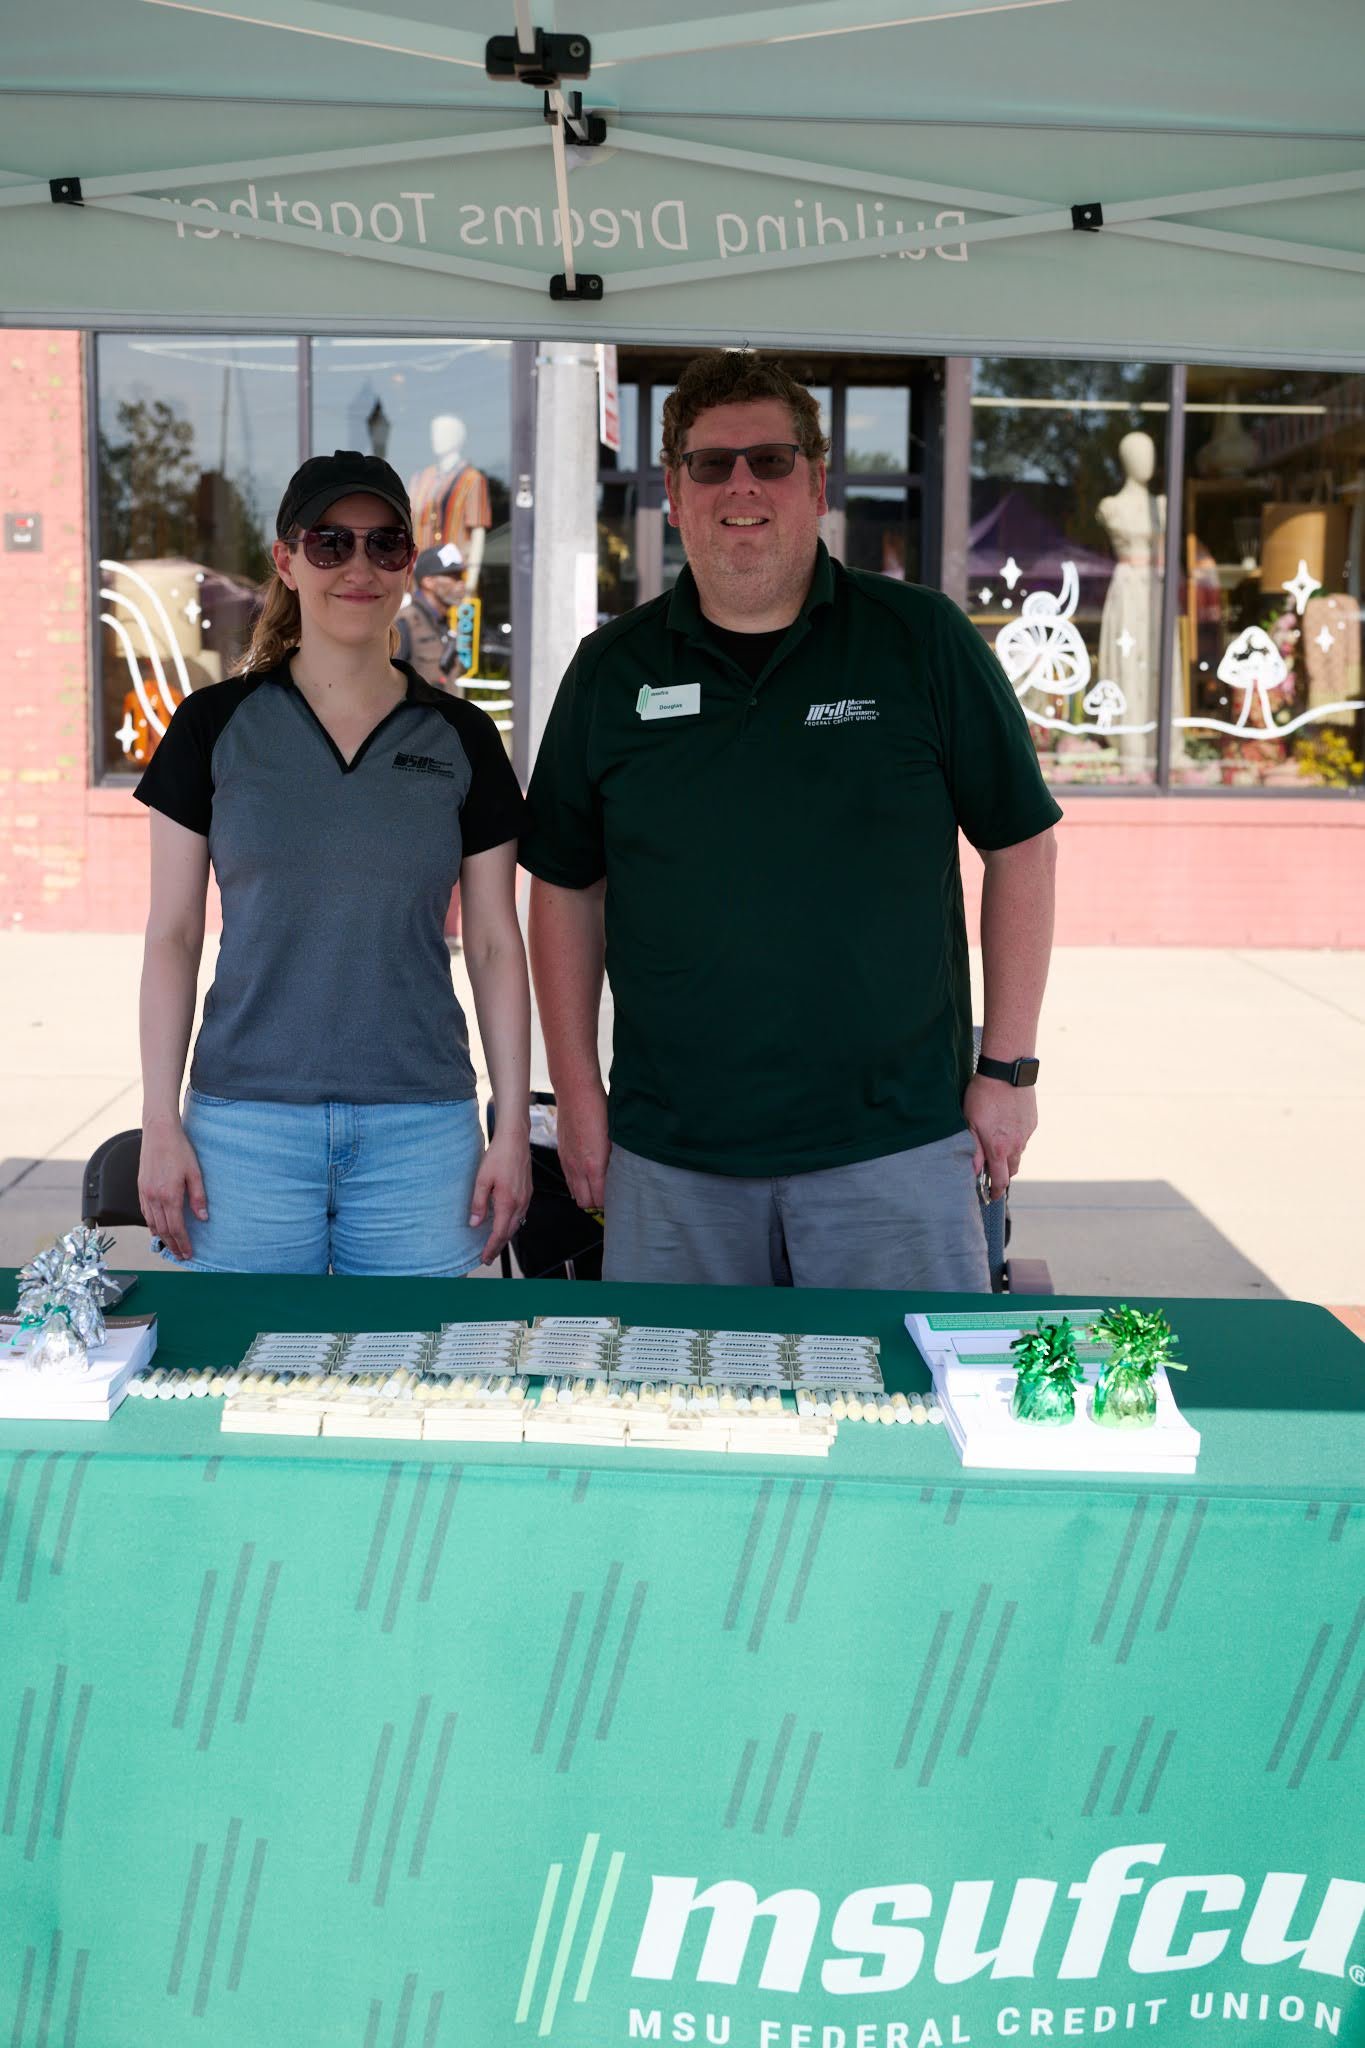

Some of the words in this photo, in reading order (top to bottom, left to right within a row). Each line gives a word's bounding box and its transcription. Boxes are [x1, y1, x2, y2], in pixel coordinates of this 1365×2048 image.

[631, 1843, 1365, 1995] msufcu
[628, 2008, 730, 2045] MSU
[760, 2015, 971, 2048] FEDERAL
[997, 1997, 1169, 2036] CREDIT
[1190, 1992, 1341, 2036] UNION
